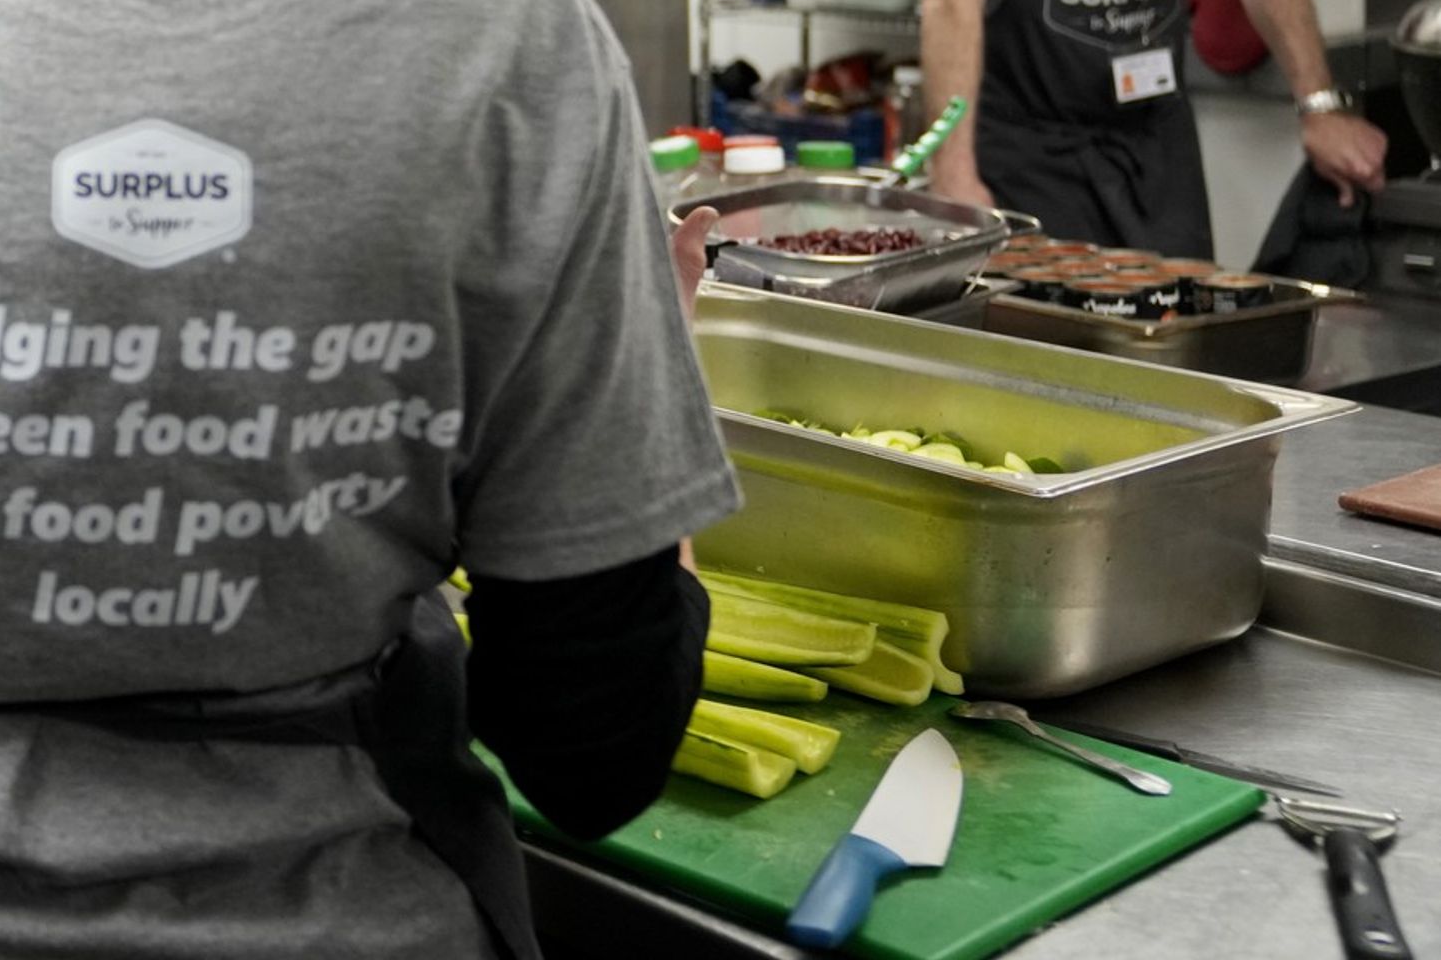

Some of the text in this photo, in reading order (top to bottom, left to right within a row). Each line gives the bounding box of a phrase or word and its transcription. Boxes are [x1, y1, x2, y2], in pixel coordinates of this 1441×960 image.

[75, 172, 230, 201] SURPLUS
[179, 311, 297, 371] the
[307, 320, 436, 381] gap
[114, 401, 279, 460] food
[290, 397, 463, 451] waste
[3, 485, 164, 544] food
[173, 471, 408, 556] poverty
[32, 568, 258, 634] locally
